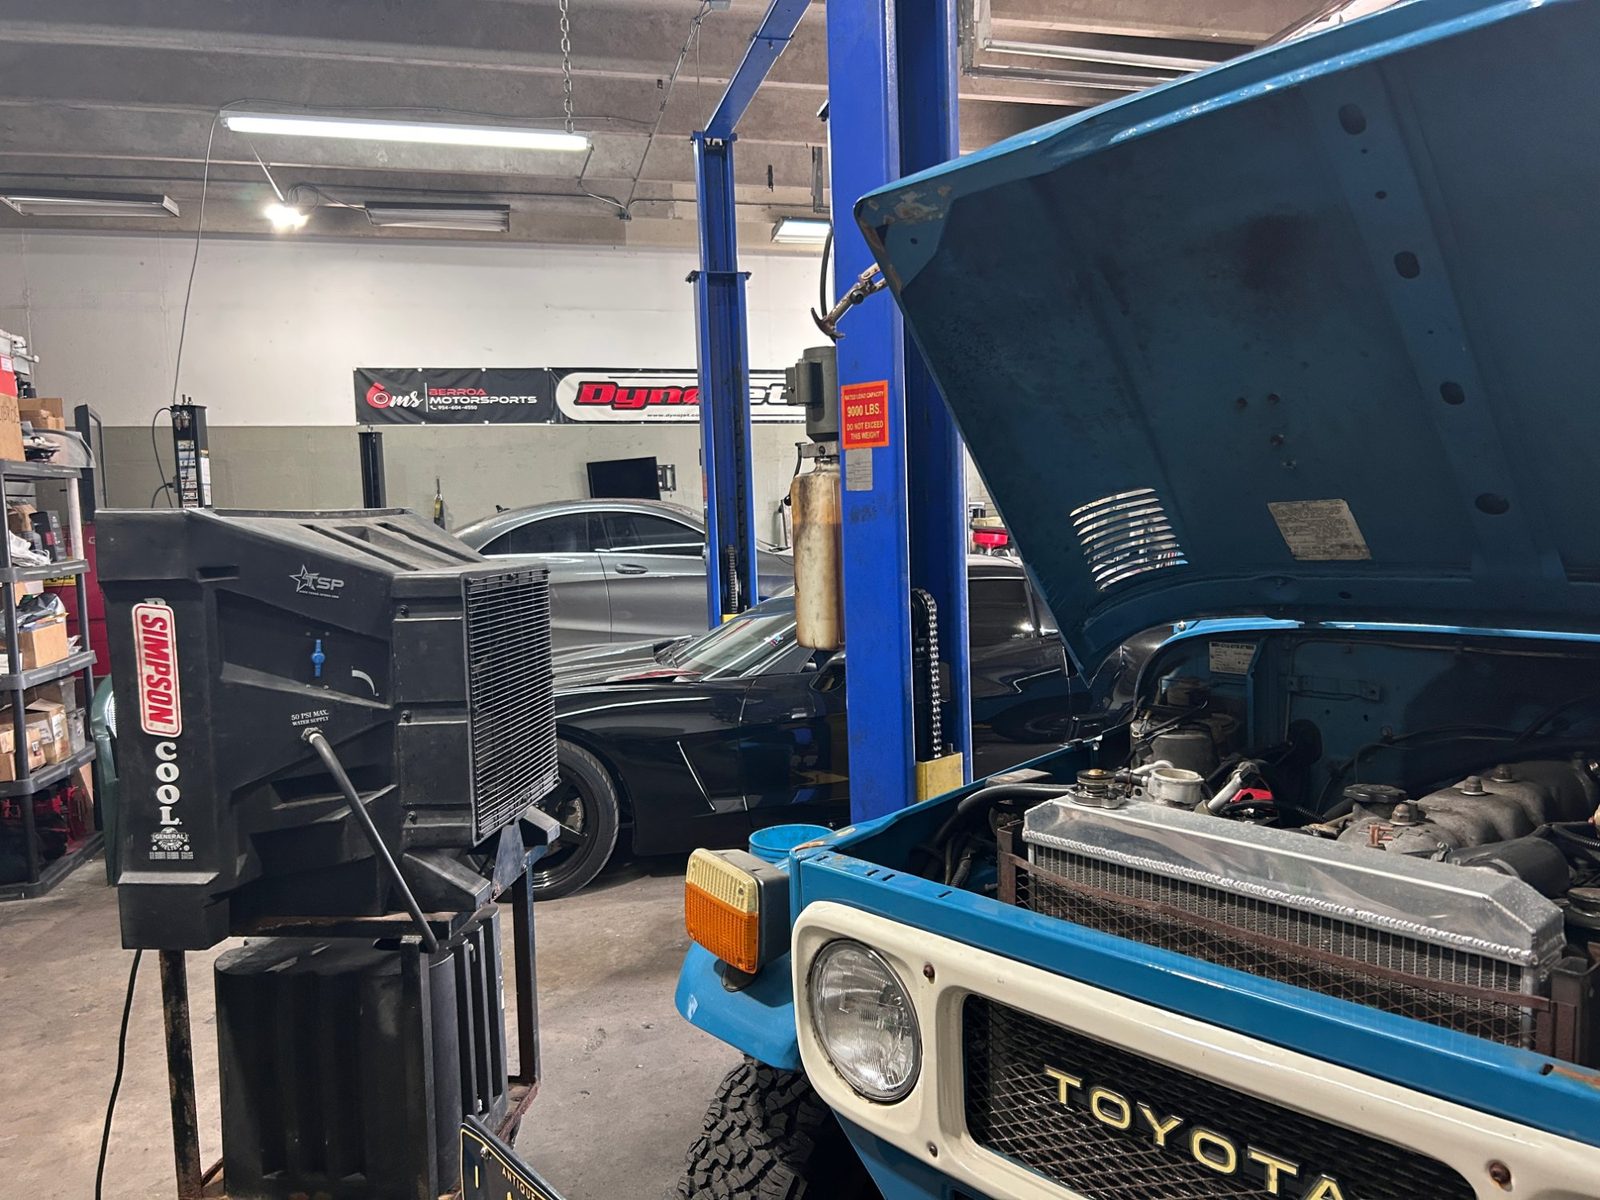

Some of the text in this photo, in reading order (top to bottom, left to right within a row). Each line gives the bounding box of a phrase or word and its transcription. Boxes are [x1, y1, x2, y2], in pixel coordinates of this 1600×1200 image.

[428, 388, 488, 396] BERROA
[429, 396, 538, 404] MOTORSPORTS
[847, 405, 863, 417] 9000
[846, 420, 884, 431] DO NOT EXCEED
[861, 431, 880, 440] WEIGHT
[141, 614, 174, 725] SIMPSON
[300, 711, 312, 719] PSI
[310, 716, 329, 724] SUPPLY
[154, 832, 186, 841] GENERAL
[1044, 1065, 1346, 1200] TOYOTA
[501, 1166, 536, 1200] ANTIQUE
